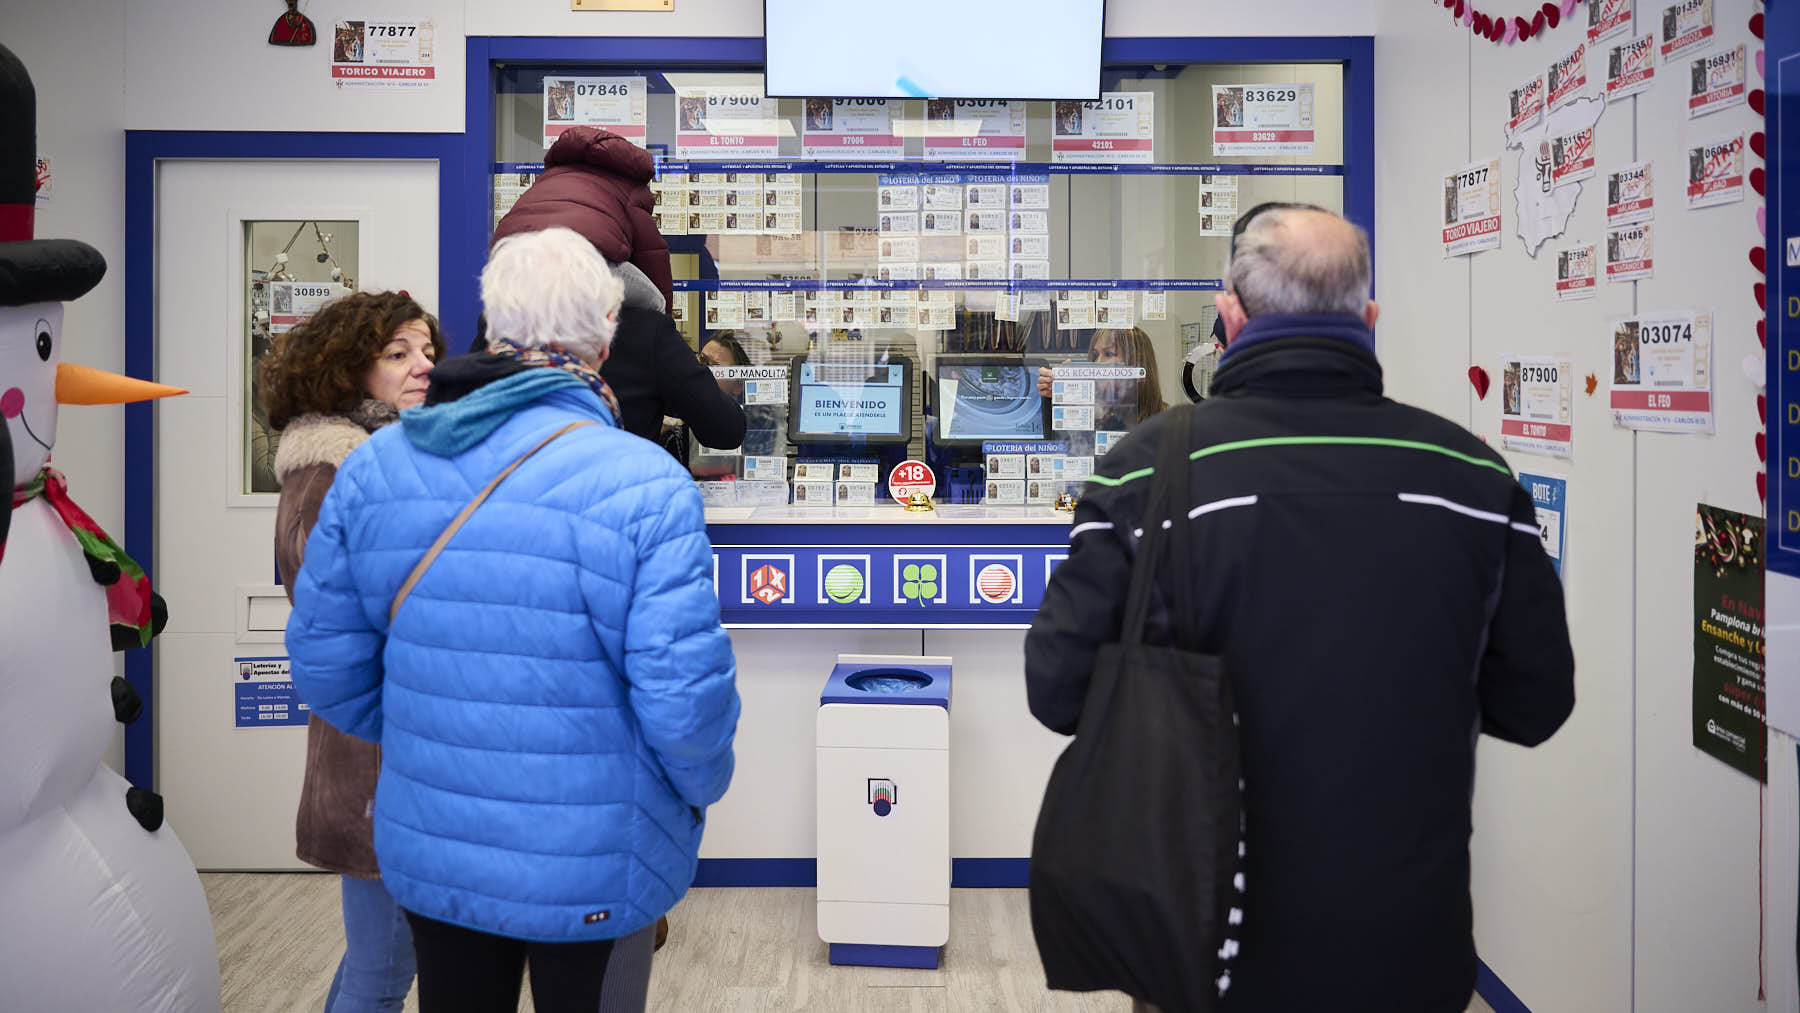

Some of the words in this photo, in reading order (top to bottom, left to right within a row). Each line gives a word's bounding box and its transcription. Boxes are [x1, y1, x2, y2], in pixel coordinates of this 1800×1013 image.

[368, 26, 416, 37] 77877
[1706, 50, 1735, 70] 36931
[339, 67, 379, 76] TORICO
[381, 68, 426, 77] VIAJERO
[577, 84, 628, 96] 07846
[1245, 90, 1297, 102] 83629
[708, 93, 760, 106] 87900
[1083, 98, 1134, 110] 42101
[711, 136, 720, 146] EL
[721, 136, 744, 146] TONTO
[962, 137, 972, 147] EL
[973, 137, 988, 147] FEO
[921, 175, 933, 184] del
[1006, 175, 1018, 183] del
[1457, 167, 1489, 190] 77877
[1445, 225, 1466, 241] TORICO
[1467, 218, 1498, 236] VIAJERO
[294, 287, 331, 297] 30899
[1641, 323, 1692, 345] 03074
[740, 369, 786, 378] MANOLITA
[1072, 368, 1134, 377] RECHAZADOS
[1521, 366, 1558, 384] 87900
[815, 400, 887, 410] BIENVENIDO
[1648, 394, 1657, 408] EL
[1657, 394, 1671, 409] FEO
[1522, 424, 1530, 435] EL
[1024, 444, 1036, 452] del
[1038, 443, 1058, 452] NIÑO
[898, 465, 925, 481] +18
[1532, 482, 1551, 502] BOTE
[1721, 593, 1736, 611] En
[1711, 608, 1751, 633] Pamplona
[1701, 618, 1746, 648] Ensanche
[1746, 638, 1754, 654] y
[1714, 644, 1738, 661] Compra
[1718, 693, 1730, 706] con
[1730, 697, 1743, 712] más
[1743, 704, 1752, 716] de
